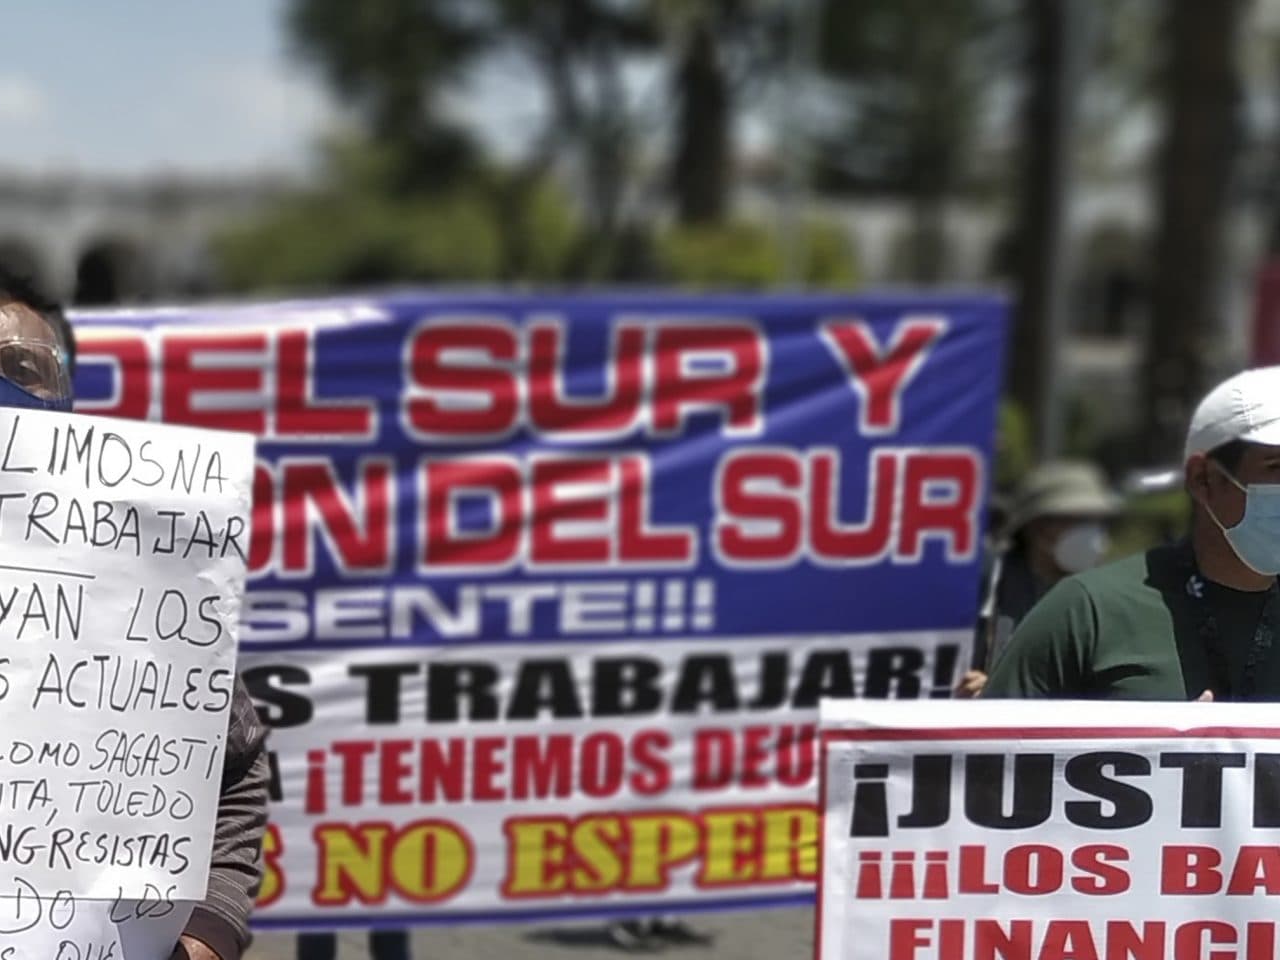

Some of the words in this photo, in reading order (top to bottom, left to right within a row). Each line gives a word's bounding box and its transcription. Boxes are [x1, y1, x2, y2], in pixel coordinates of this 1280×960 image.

[402, 318, 768, 440] SUR
[818, 318, 948, 436] Y
[1, 416, 230, 494] LIMOSNA
[417, 453, 697, 575] DEL
[712, 448, 986, 565] SUR
[32, 655, 232, 713] ACTUALES
[348, 643, 961, 719] TRABAJAR!
[67, 779, 195, 821] TOLEDO
[304, 729, 668, 815] ¡TENEMOS
[312, 817, 476, 907] NO
[1160, 845, 1280, 896] BA
